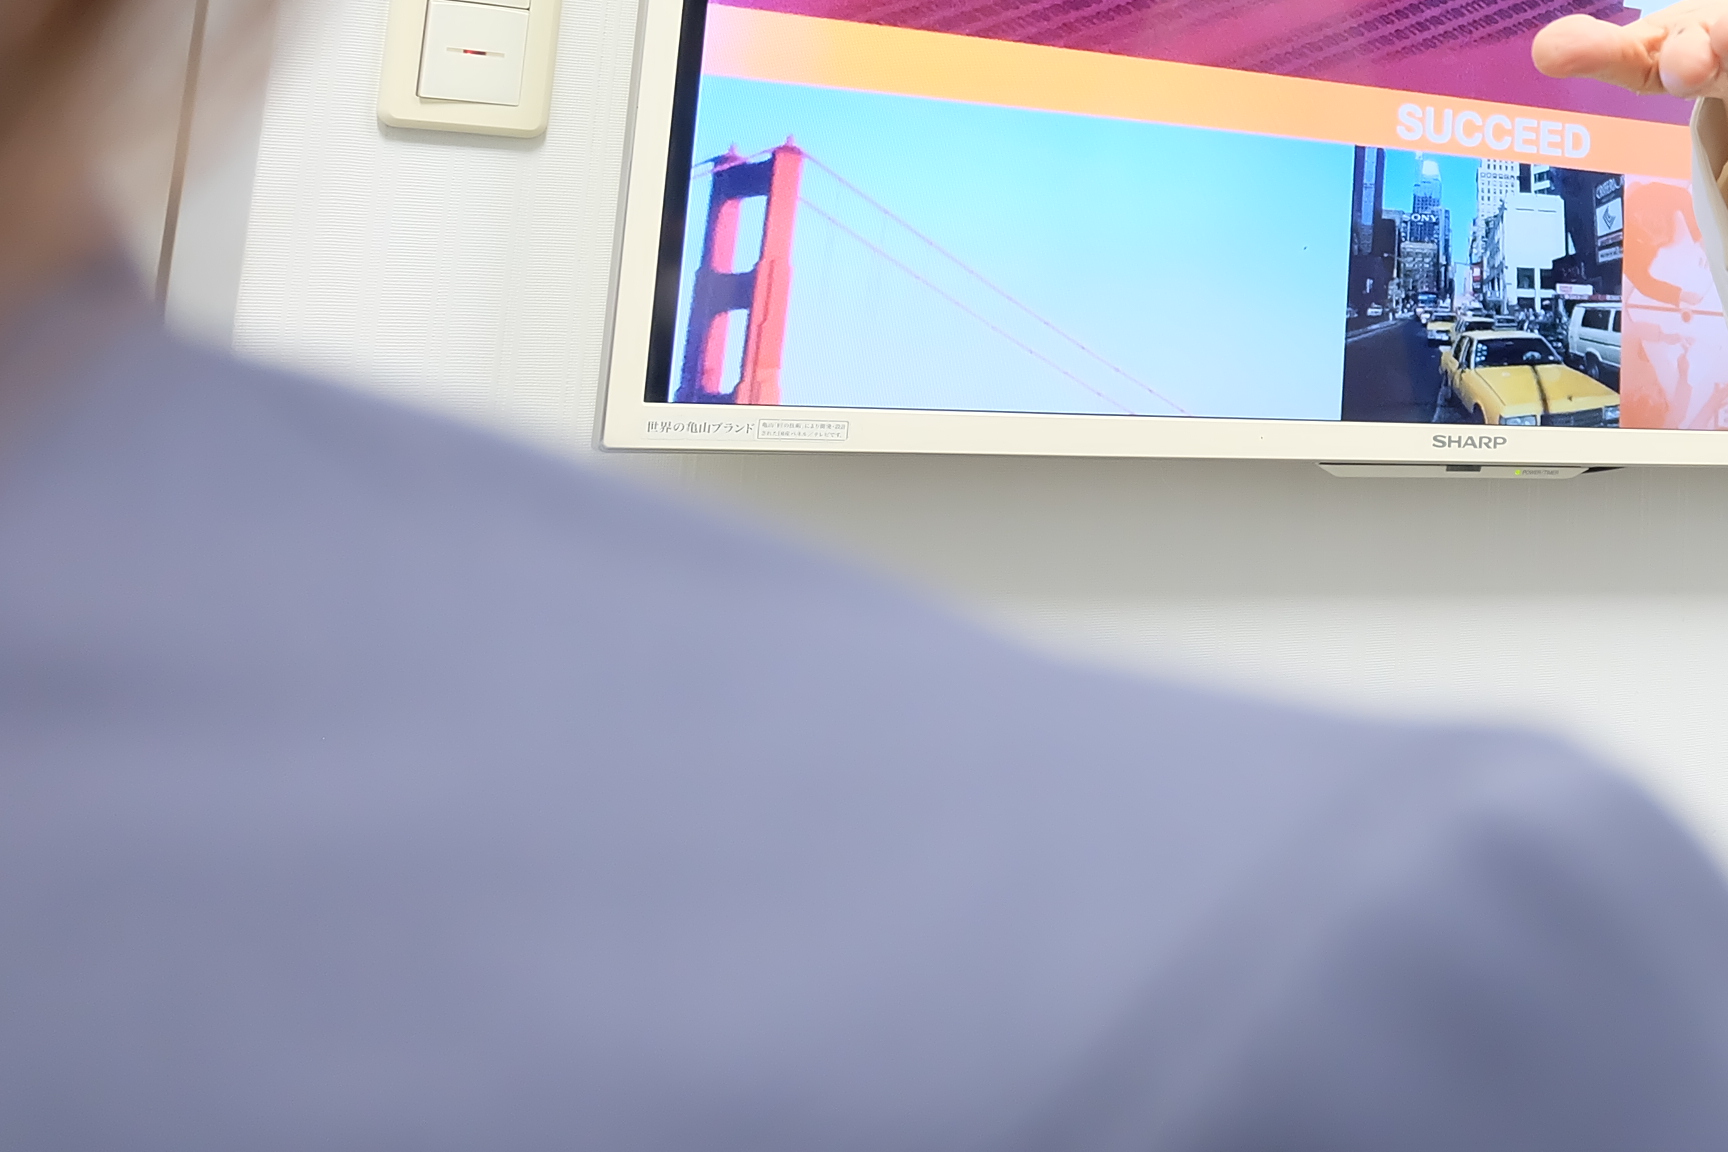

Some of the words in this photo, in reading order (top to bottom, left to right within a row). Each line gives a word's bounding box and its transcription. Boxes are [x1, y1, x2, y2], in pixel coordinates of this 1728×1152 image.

[1396, 103, 1591, 158] SUCCEED
[646, 421, 755, 434] 世界の亀山ブランド
[1432, 435, 1507, 449] SHARP
